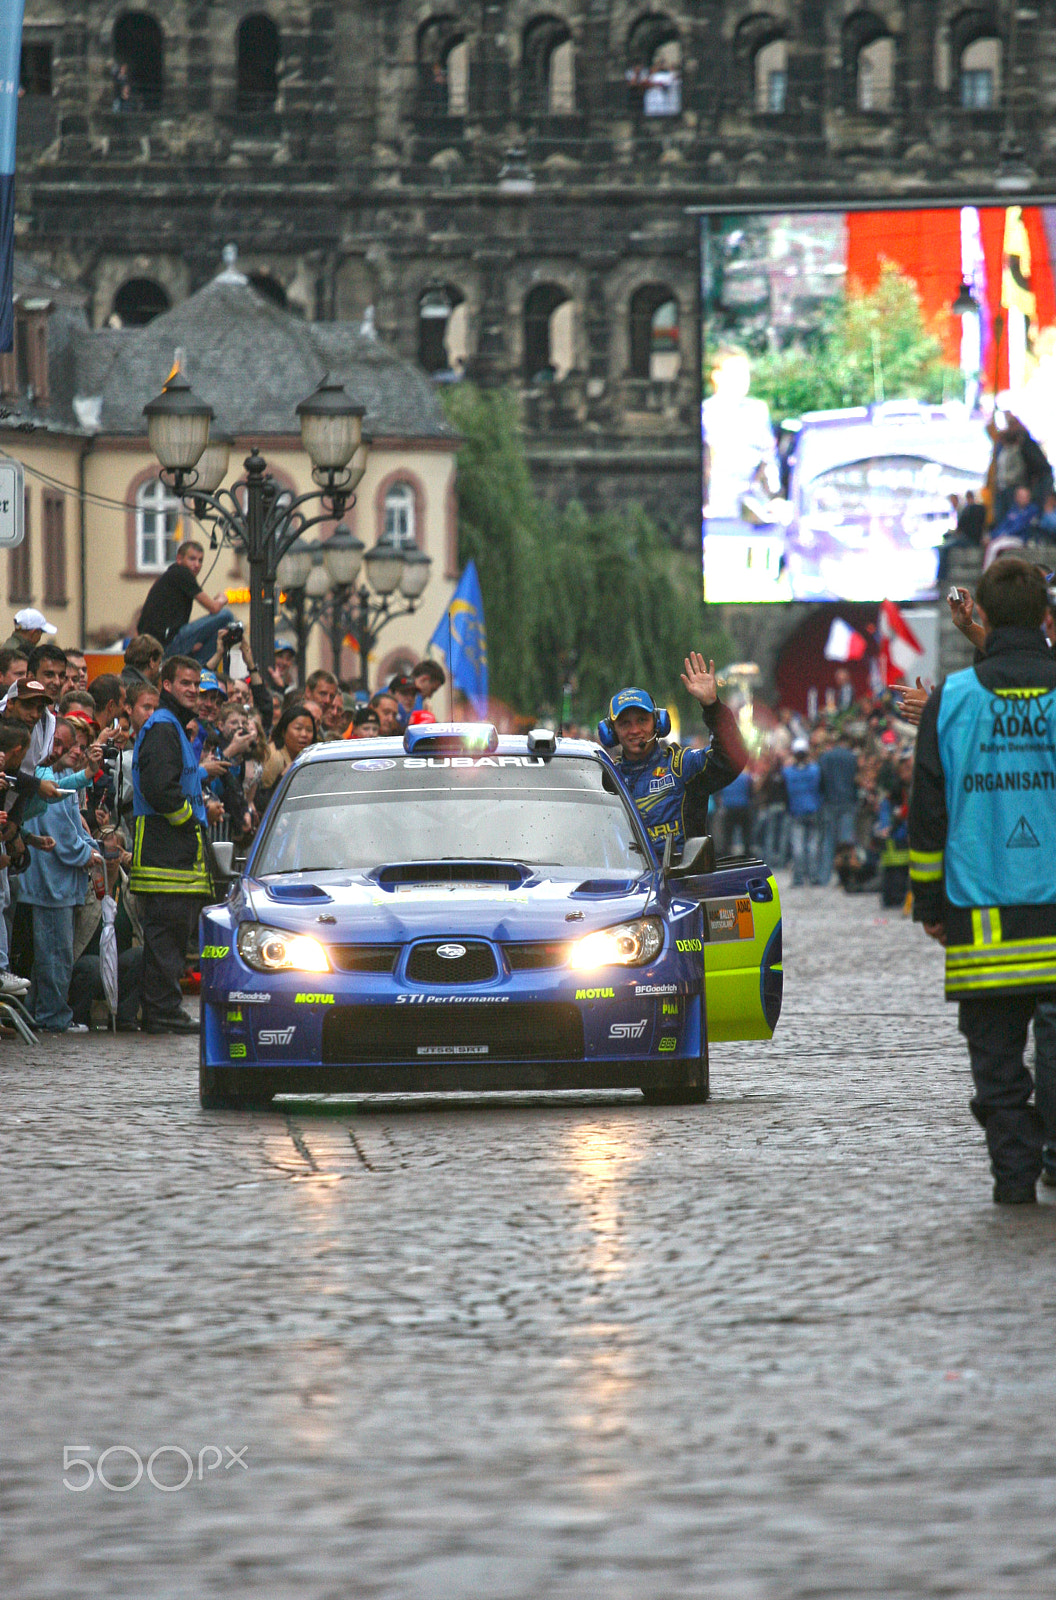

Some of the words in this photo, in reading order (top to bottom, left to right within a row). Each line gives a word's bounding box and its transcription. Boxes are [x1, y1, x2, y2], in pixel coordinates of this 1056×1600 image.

[992, 716, 1047, 737] ADAC
[403, 757, 545, 768] SUBARU
[736, 900, 751, 914] ADAC
[719, 909, 735, 919] RALLYE
[675, 938, 702, 952] DENSO
[200, 945, 230, 958] DENSO
[575, 987, 615, 1000] MOTUL
[635, 984, 678, 994] BFGoodrich
[228, 991, 271, 1001] BFGoodrich
[294, 993, 335, 1004] MOTUL
[395, 993, 425, 1004] STI
[426, 995, 510, 1003] Performance
[662, 1003, 679, 1014] PIAA
[659, 1038, 676, 1050] BBS
